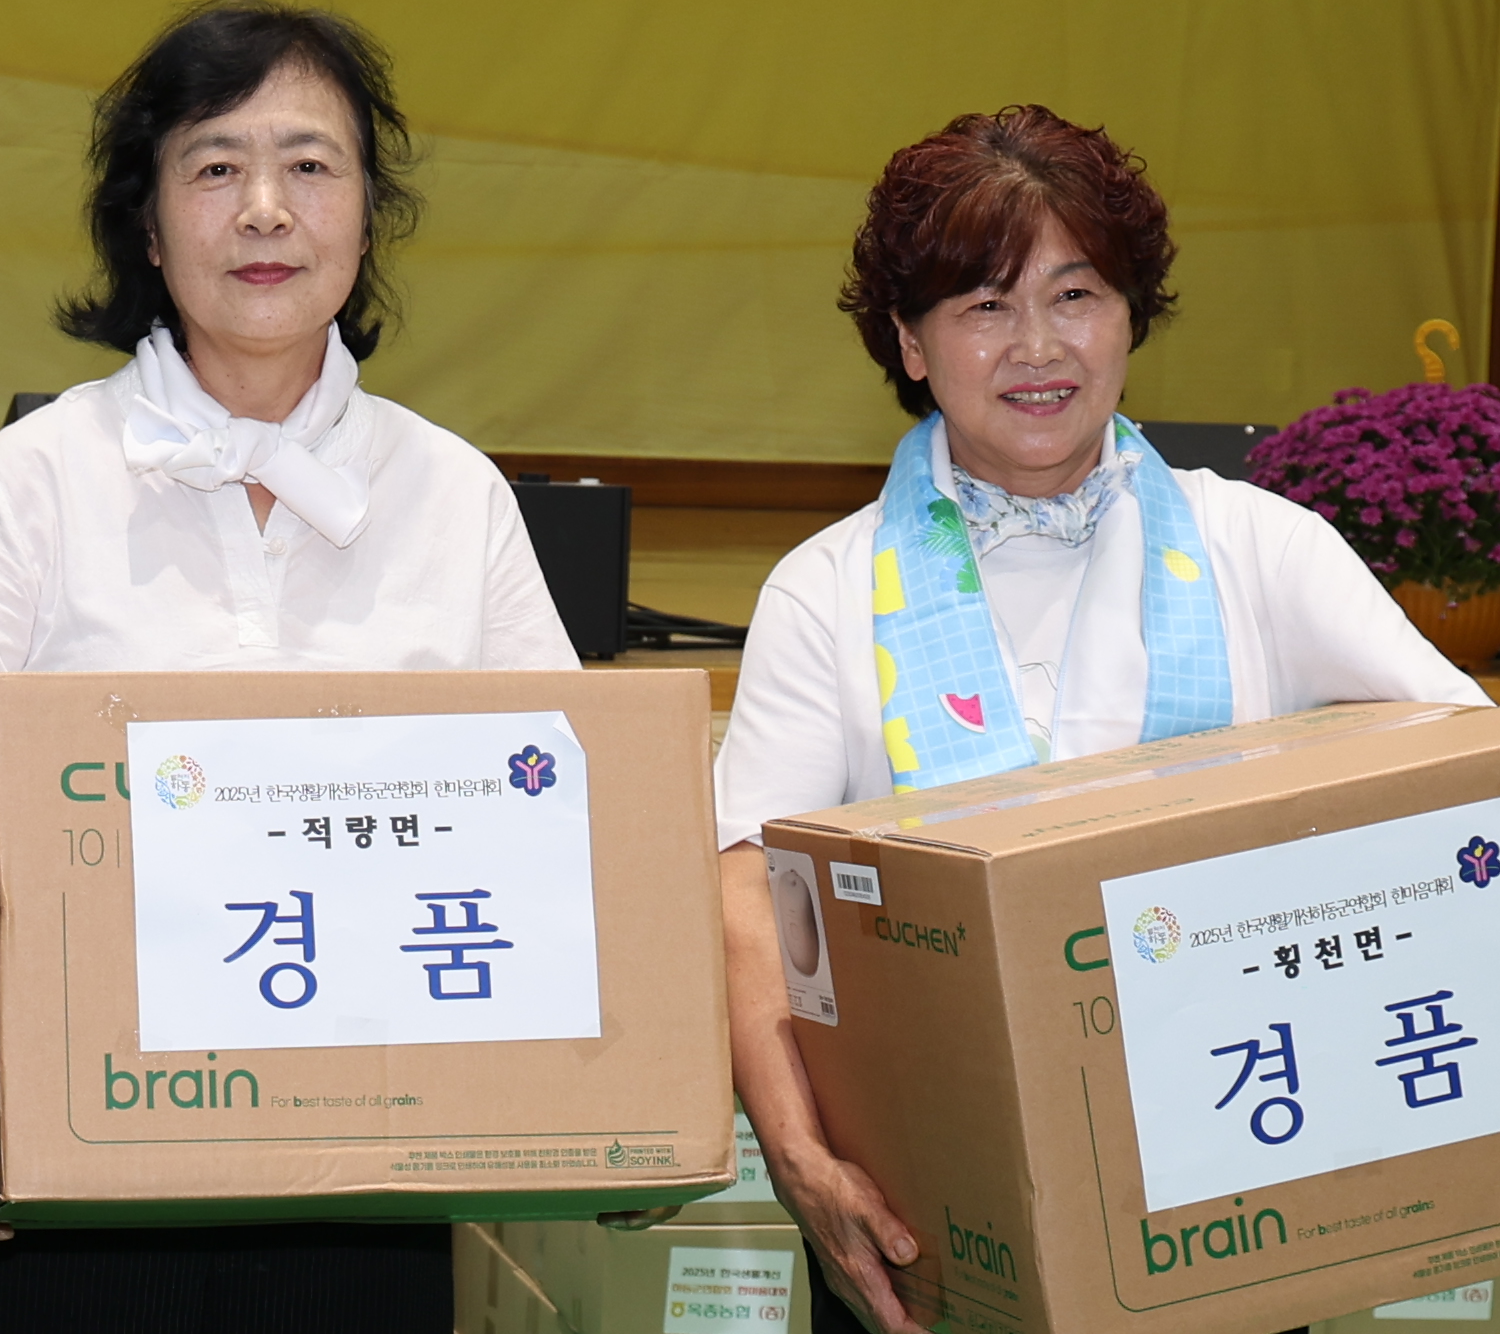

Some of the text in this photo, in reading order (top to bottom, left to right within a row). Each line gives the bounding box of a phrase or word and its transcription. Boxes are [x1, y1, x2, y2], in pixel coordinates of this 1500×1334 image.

[214, 778, 503, 803] 2025년 한국생활개선하동군연합회 한마음대회
[302, 814, 419, 850] 적량면
[223, 888, 514, 1009] 경 품
[1189, 875, 1455, 948] 2025년 한국생활개선하동군연합회 한마음대회
[104, 1052, 424, 1110] brain For best taste of all grains
[1210, 989, 1480, 1146] 경 품
[944, 1205, 1017, 1283] brain
[1140, 1198, 1435, 1276] brain For best taste of all grains
